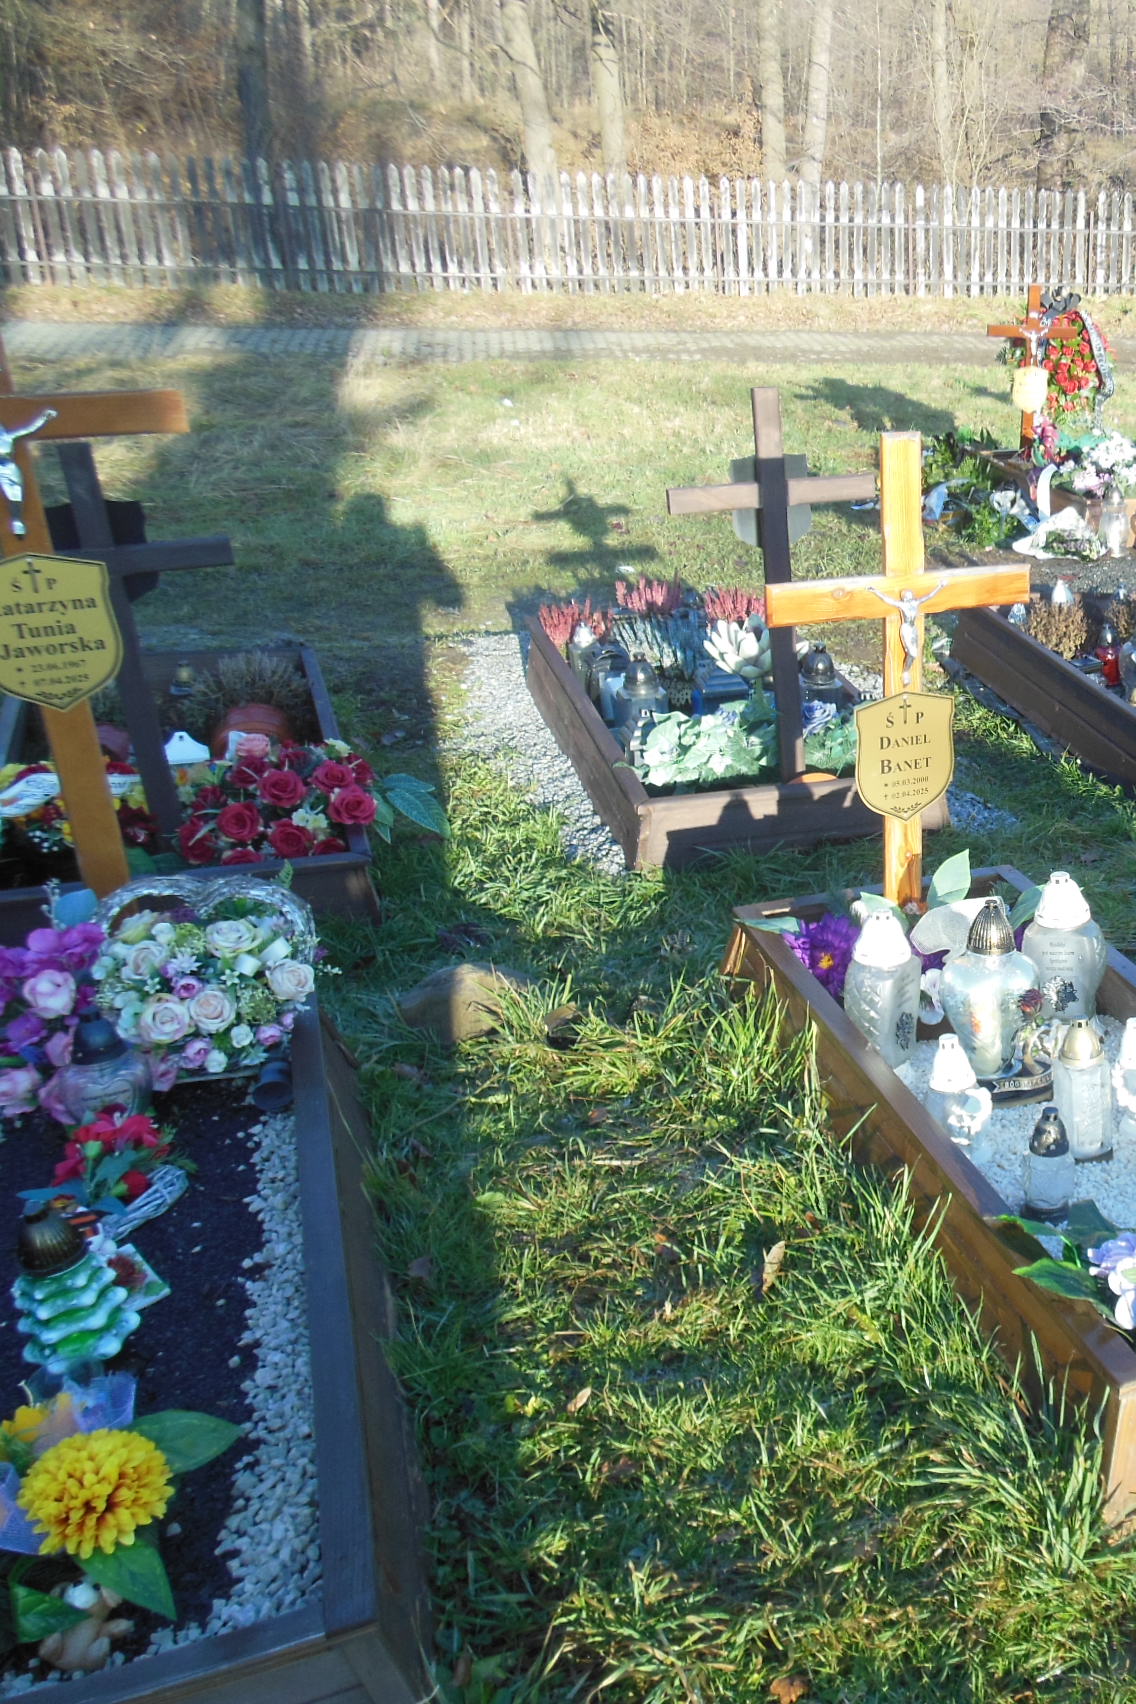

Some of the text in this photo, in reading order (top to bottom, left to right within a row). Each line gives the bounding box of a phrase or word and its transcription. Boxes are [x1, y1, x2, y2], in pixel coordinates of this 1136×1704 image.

[46, 577, 57, 591] P
[0, 596, 97, 616] atarzyna
[12, 620, 77, 640] Tunia
[0, 637, 106, 661] Jaworska
[915, 711, 925, 725] P
[879, 734, 931, 751] DANIEL
[880, 756, 932, 775] BANET
